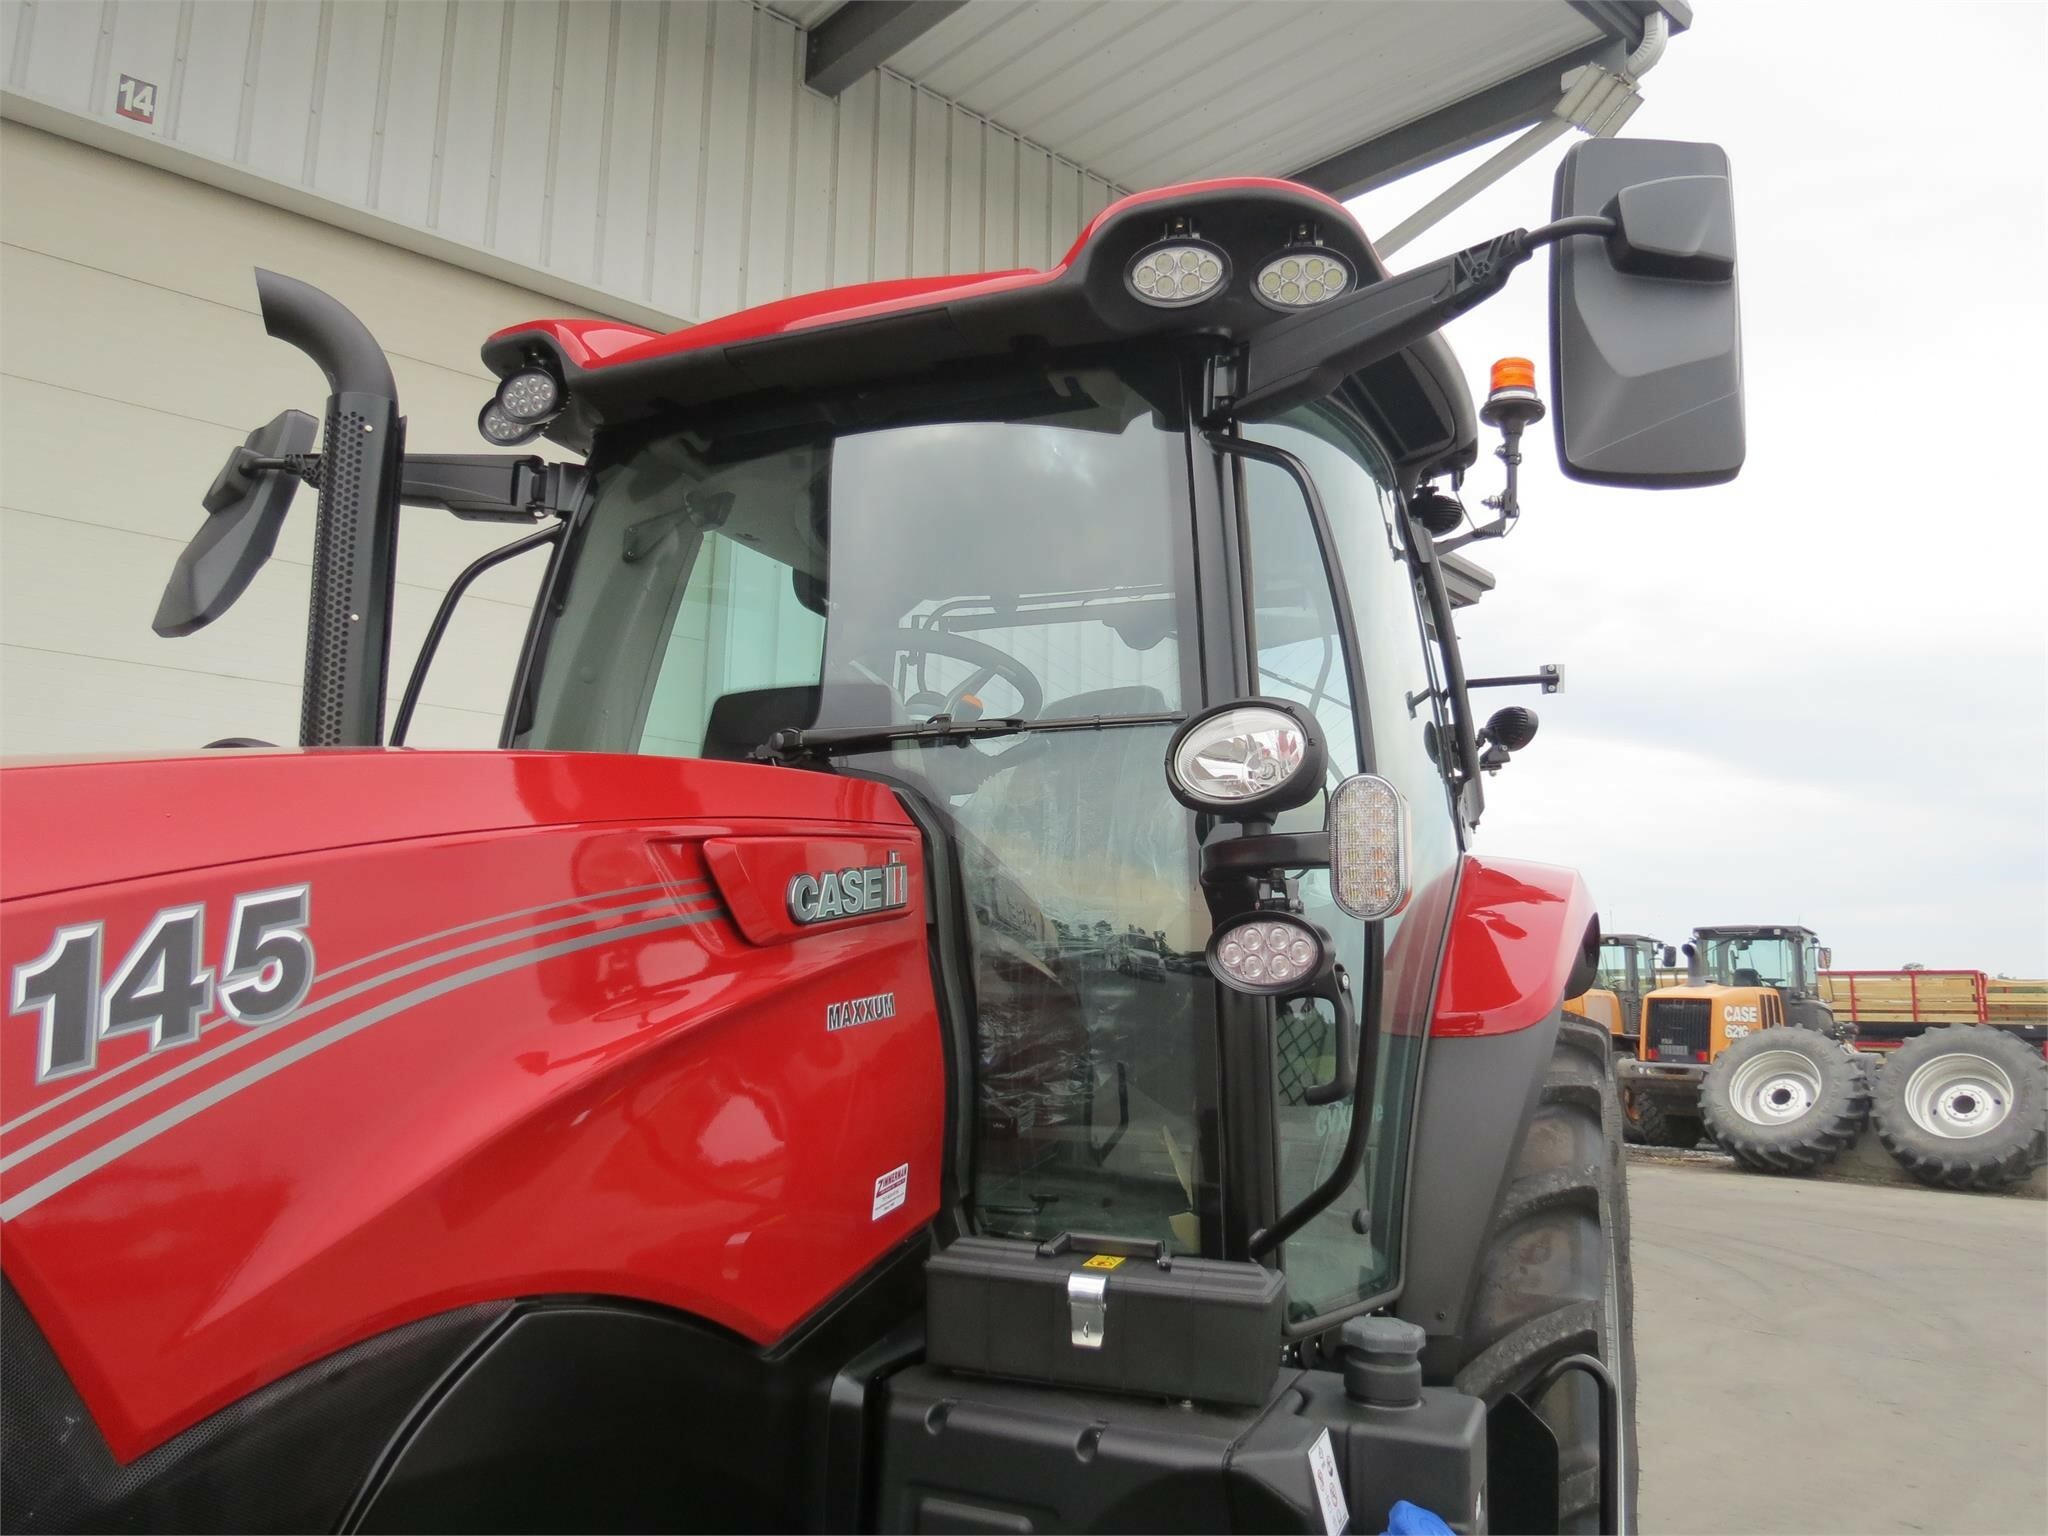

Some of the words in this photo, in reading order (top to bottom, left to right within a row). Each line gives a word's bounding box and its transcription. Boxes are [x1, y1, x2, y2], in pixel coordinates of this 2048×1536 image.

[120, 80, 154, 117] 14
[787, 868, 883, 924] CASE
[10, 883, 316, 1085] 145
[827, 993, 896, 1032] MAXXUM
[1724, 1004, 1758, 1023] CASE
